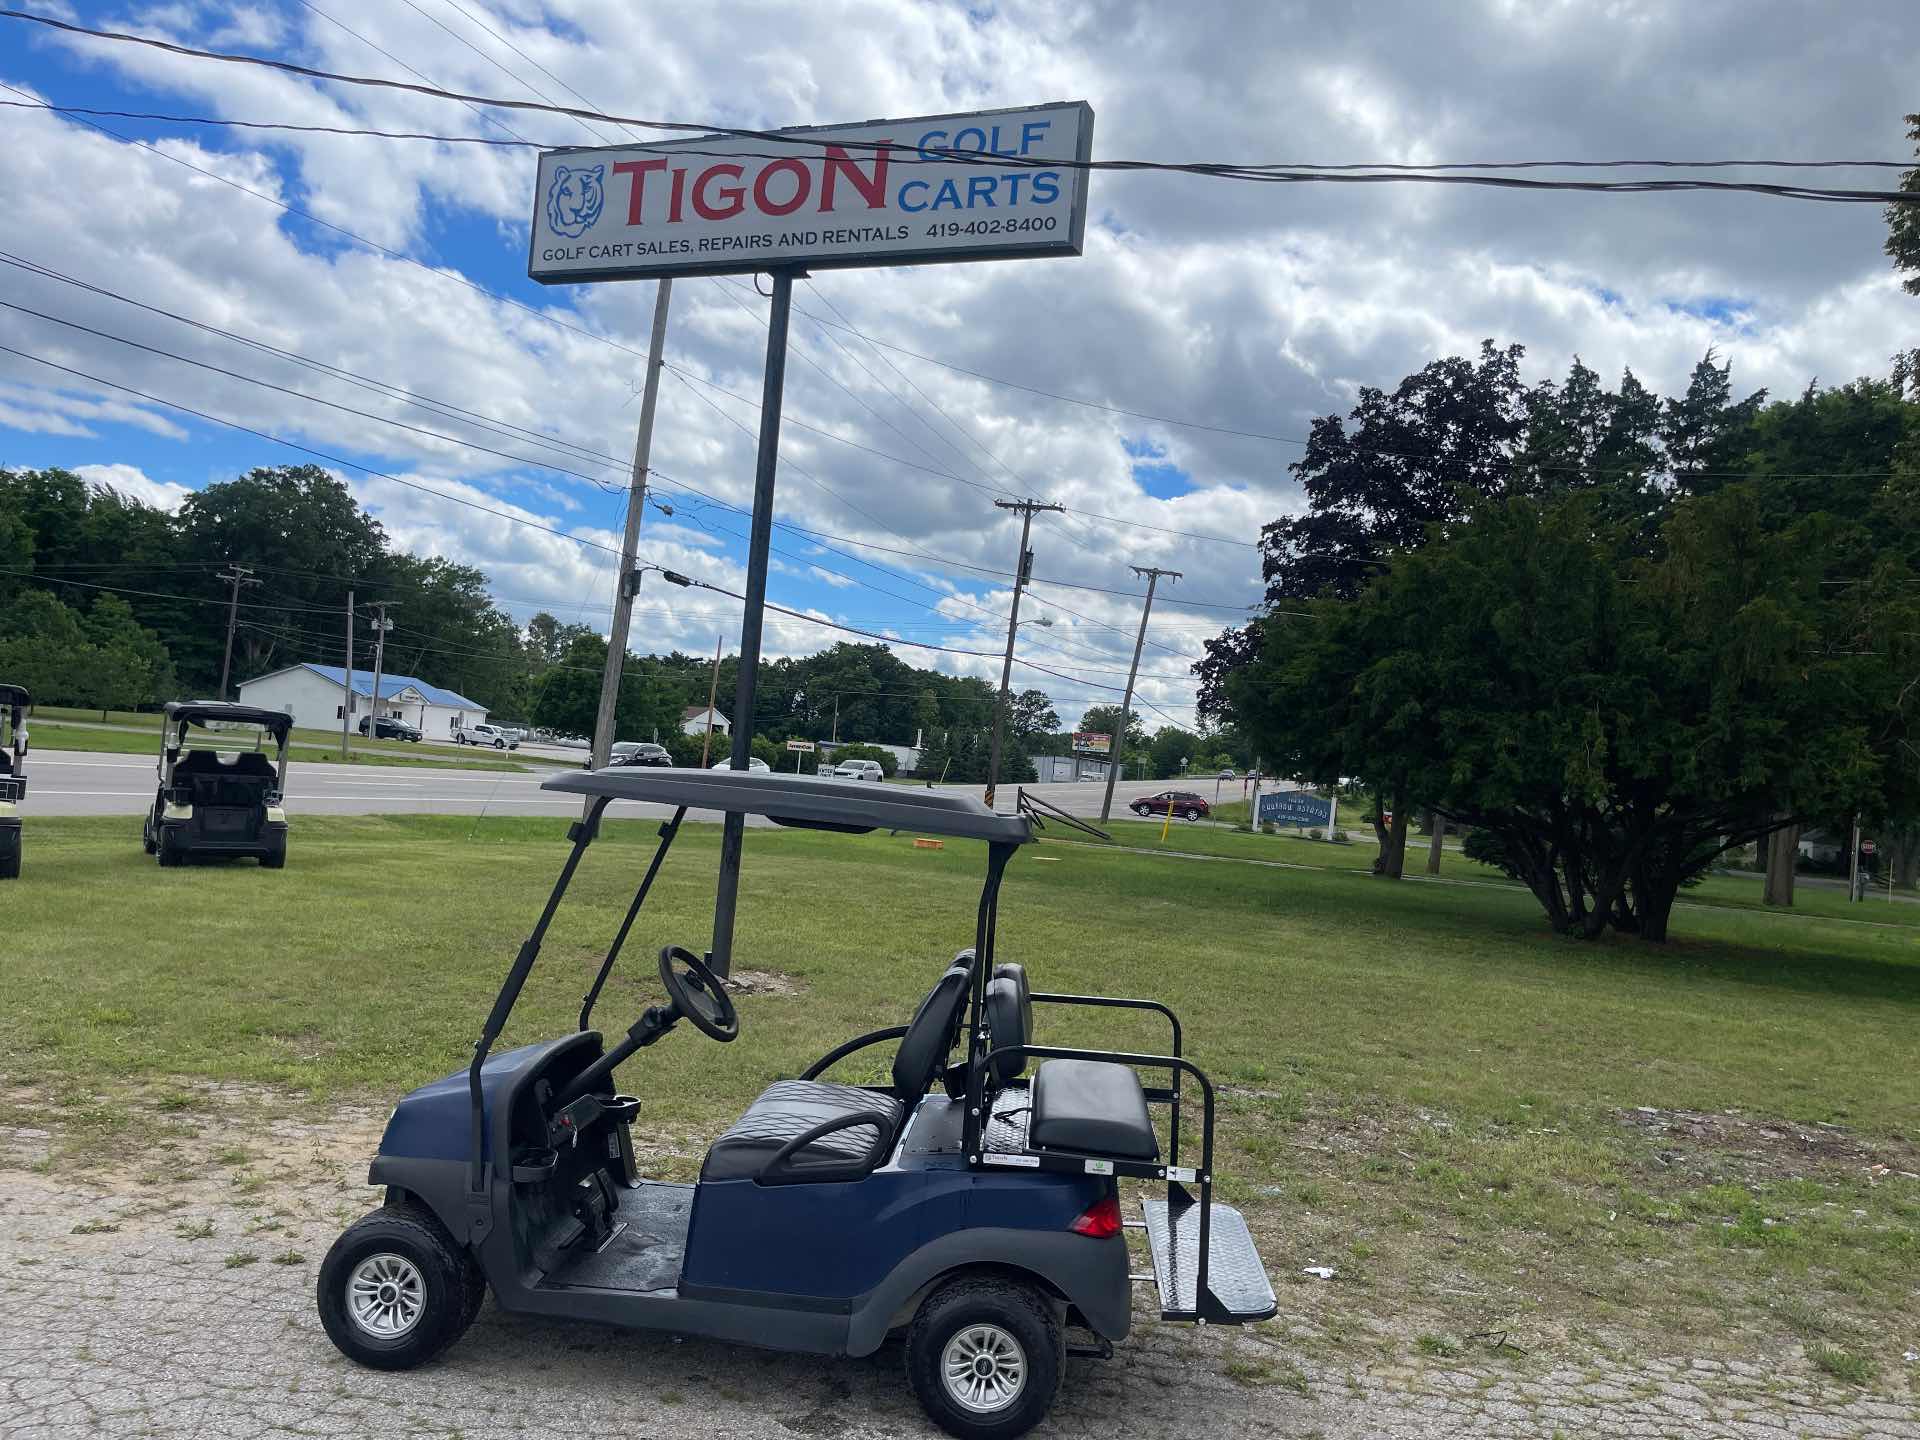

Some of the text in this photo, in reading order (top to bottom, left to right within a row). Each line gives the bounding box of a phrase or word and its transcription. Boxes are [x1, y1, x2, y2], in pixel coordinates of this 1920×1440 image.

[917, 120, 1051, 161] GOLF
[612, 138, 895, 226] TIGON
[898, 171, 1061, 213] CARTS
[542, 225, 910, 261] GOLF CART SALES, REPAIRS AND RENTALS
[926, 216, 1057, 238] 419-402-8400
